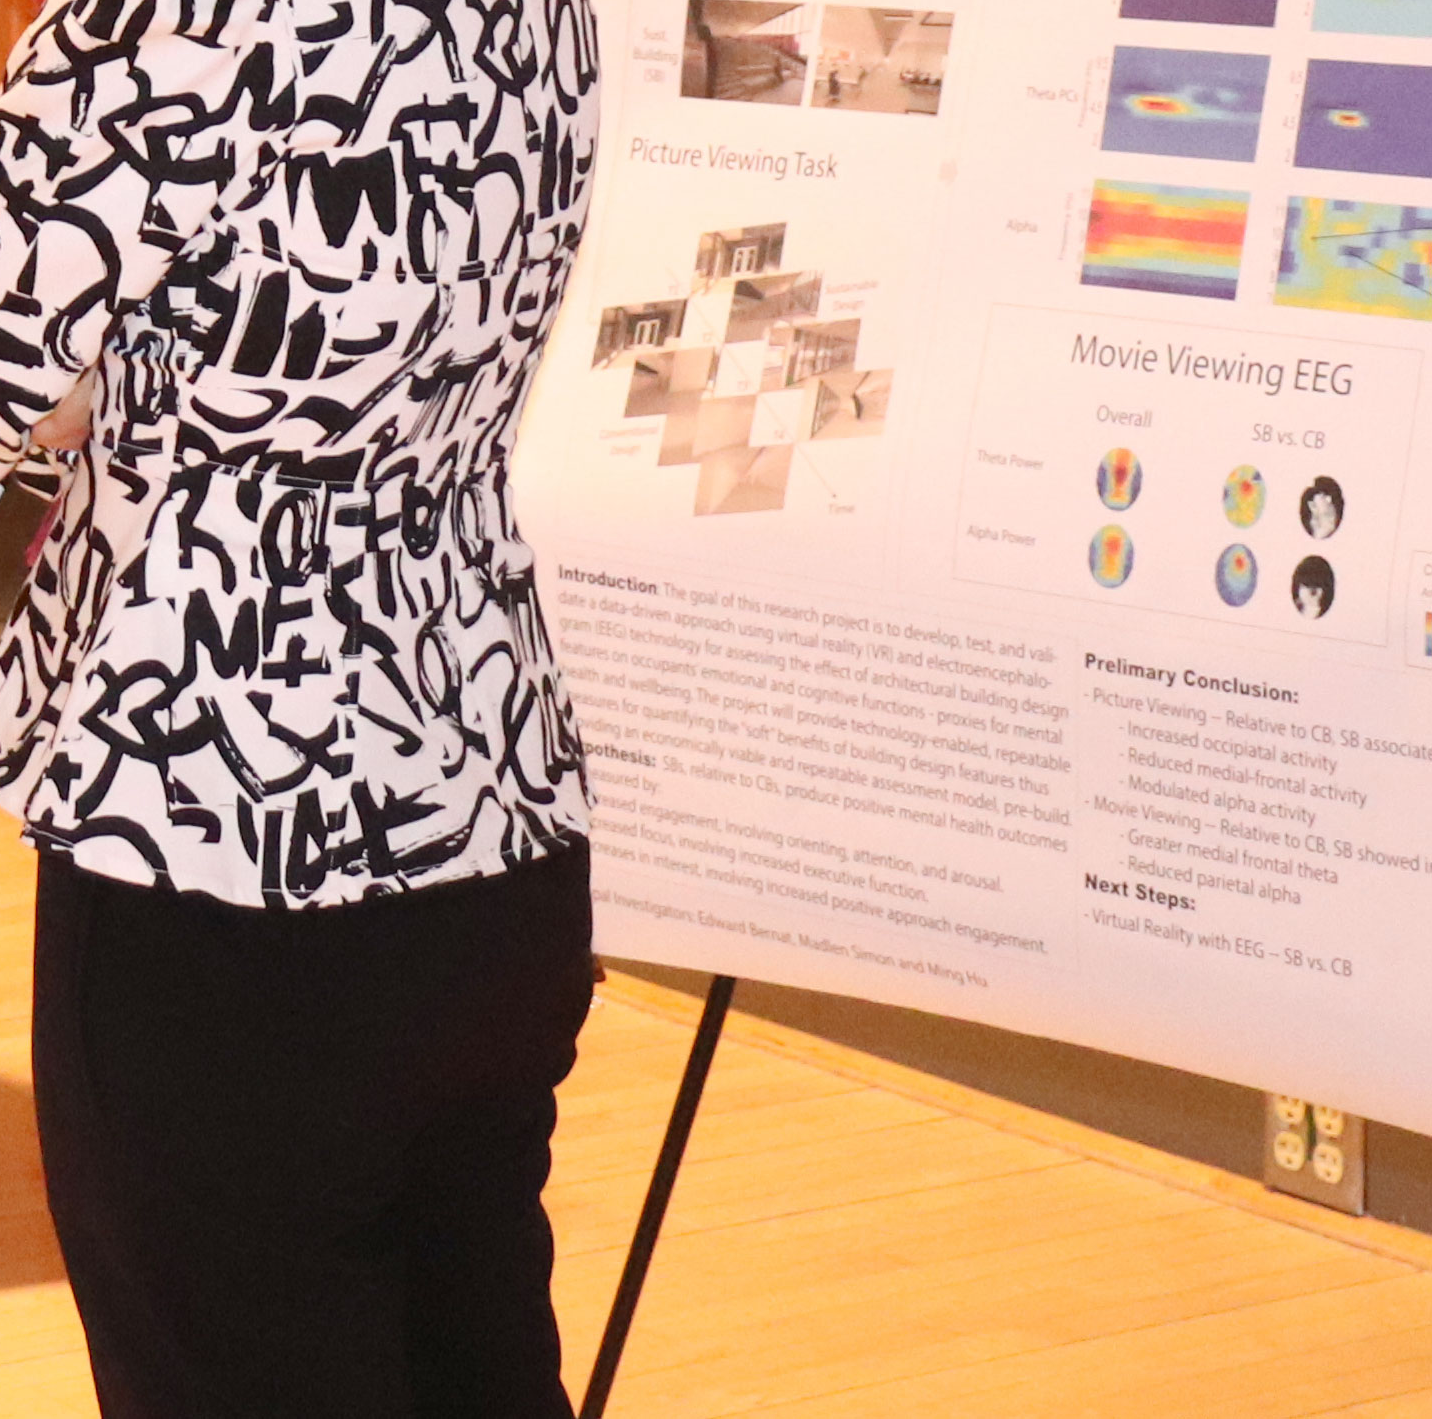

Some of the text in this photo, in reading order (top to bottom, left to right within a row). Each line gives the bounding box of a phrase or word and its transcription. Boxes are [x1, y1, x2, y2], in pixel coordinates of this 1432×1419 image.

[630, 138, 838, 179] Picture Viewing Task
[1071, 334, 1354, 396] Movie Viewing EEG
[1095, 404, 1153, 428] Overall
[1251, 423, 1326, 449] SB vs. CB
[976, 449, 1044, 471] Theta Power
[967, 525, 1037, 547] Alpha Power
[599, 596, 670, 620] data-driven
[662, 583, 686, 600] The
[696, 687, 719, 703] The
[1085, 652, 1299, 704] Prelimary Conclusion:
[1093, 687, 1431, 761] Picture Viewing Relative to CB, SB associate
[586, 745, 655, 766] pothesis:
[1128, 721, 1336, 776] Increased occipiatal activity
[1128, 748, 1367, 810] Reduced medial-frontal activity
[1128, 775, 1316, 828] Modulated alpha activity
[1094, 795, 1138, 817] Movie
[1142, 804, 1200, 835] Viewing
[1221, 821, 1280, 846] Relative
[1285, 834, 1300, 849] to
[1305, 835, 1329, 857] CB,
[1334, 840, 1352, 859] SB
[1357, 847, 1419, 871] showed
[1128, 829, 1337, 883] Greater medial frontal theta
[1085, 873, 1196, 912] Next Steps:
[1128, 855, 1301, 904] Reduced parietal alpha
[1093, 907, 1352, 976] Virtual Reality with EEG SB vs. CB
